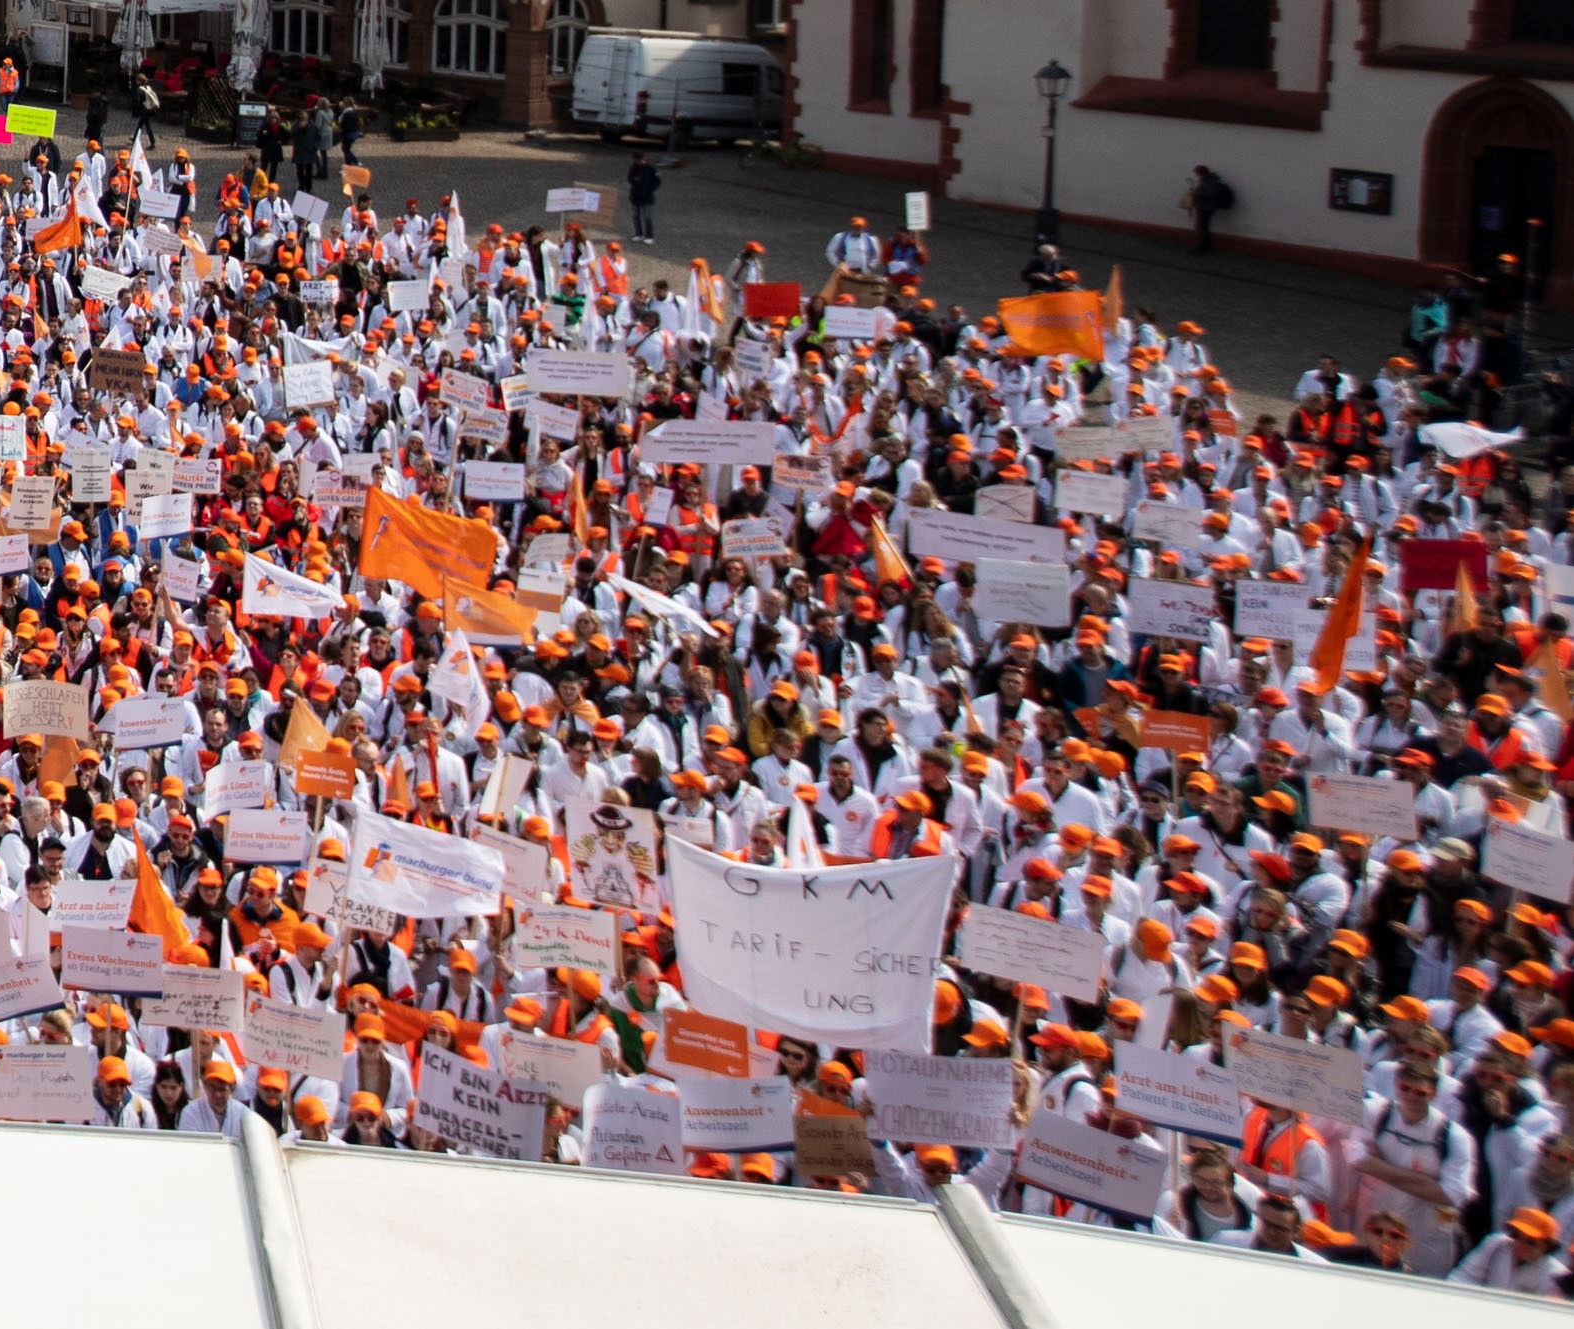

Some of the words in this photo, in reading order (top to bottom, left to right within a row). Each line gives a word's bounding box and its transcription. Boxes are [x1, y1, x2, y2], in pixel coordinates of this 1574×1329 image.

[139, 483, 154, 491] Wir
[393, 852, 462, 880] marburger
[462, 871, 494, 891] bund
[56, 901, 79, 911] Arzt
[79, 903, 95, 911] am
[95, 901, 120, 911] Limit
[67, 951, 96, 963] Freies
[97, 953, 158, 969] Wochenende
[79, 962, 111, 977] Freitag
[802, 988, 875, 1014] UNG
[423, 1050, 452, 1076] ICH
[460, 1068, 492, 1094] BIN
[451, 1086, 500, 1117] KEIN
[1120, 1072, 1152, 1088] Arzt
[1154, 1081, 1178, 1095] am
[1181, 1083, 1221, 1107] Limit
[418, 1099, 524, 1140] DURACELL-
[683, 1105, 764, 1119] Anwesenheit
[1188, 1102, 1236, 1125] Gefahr
[1031, 1135, 1128, 1180] Anwesenheit
